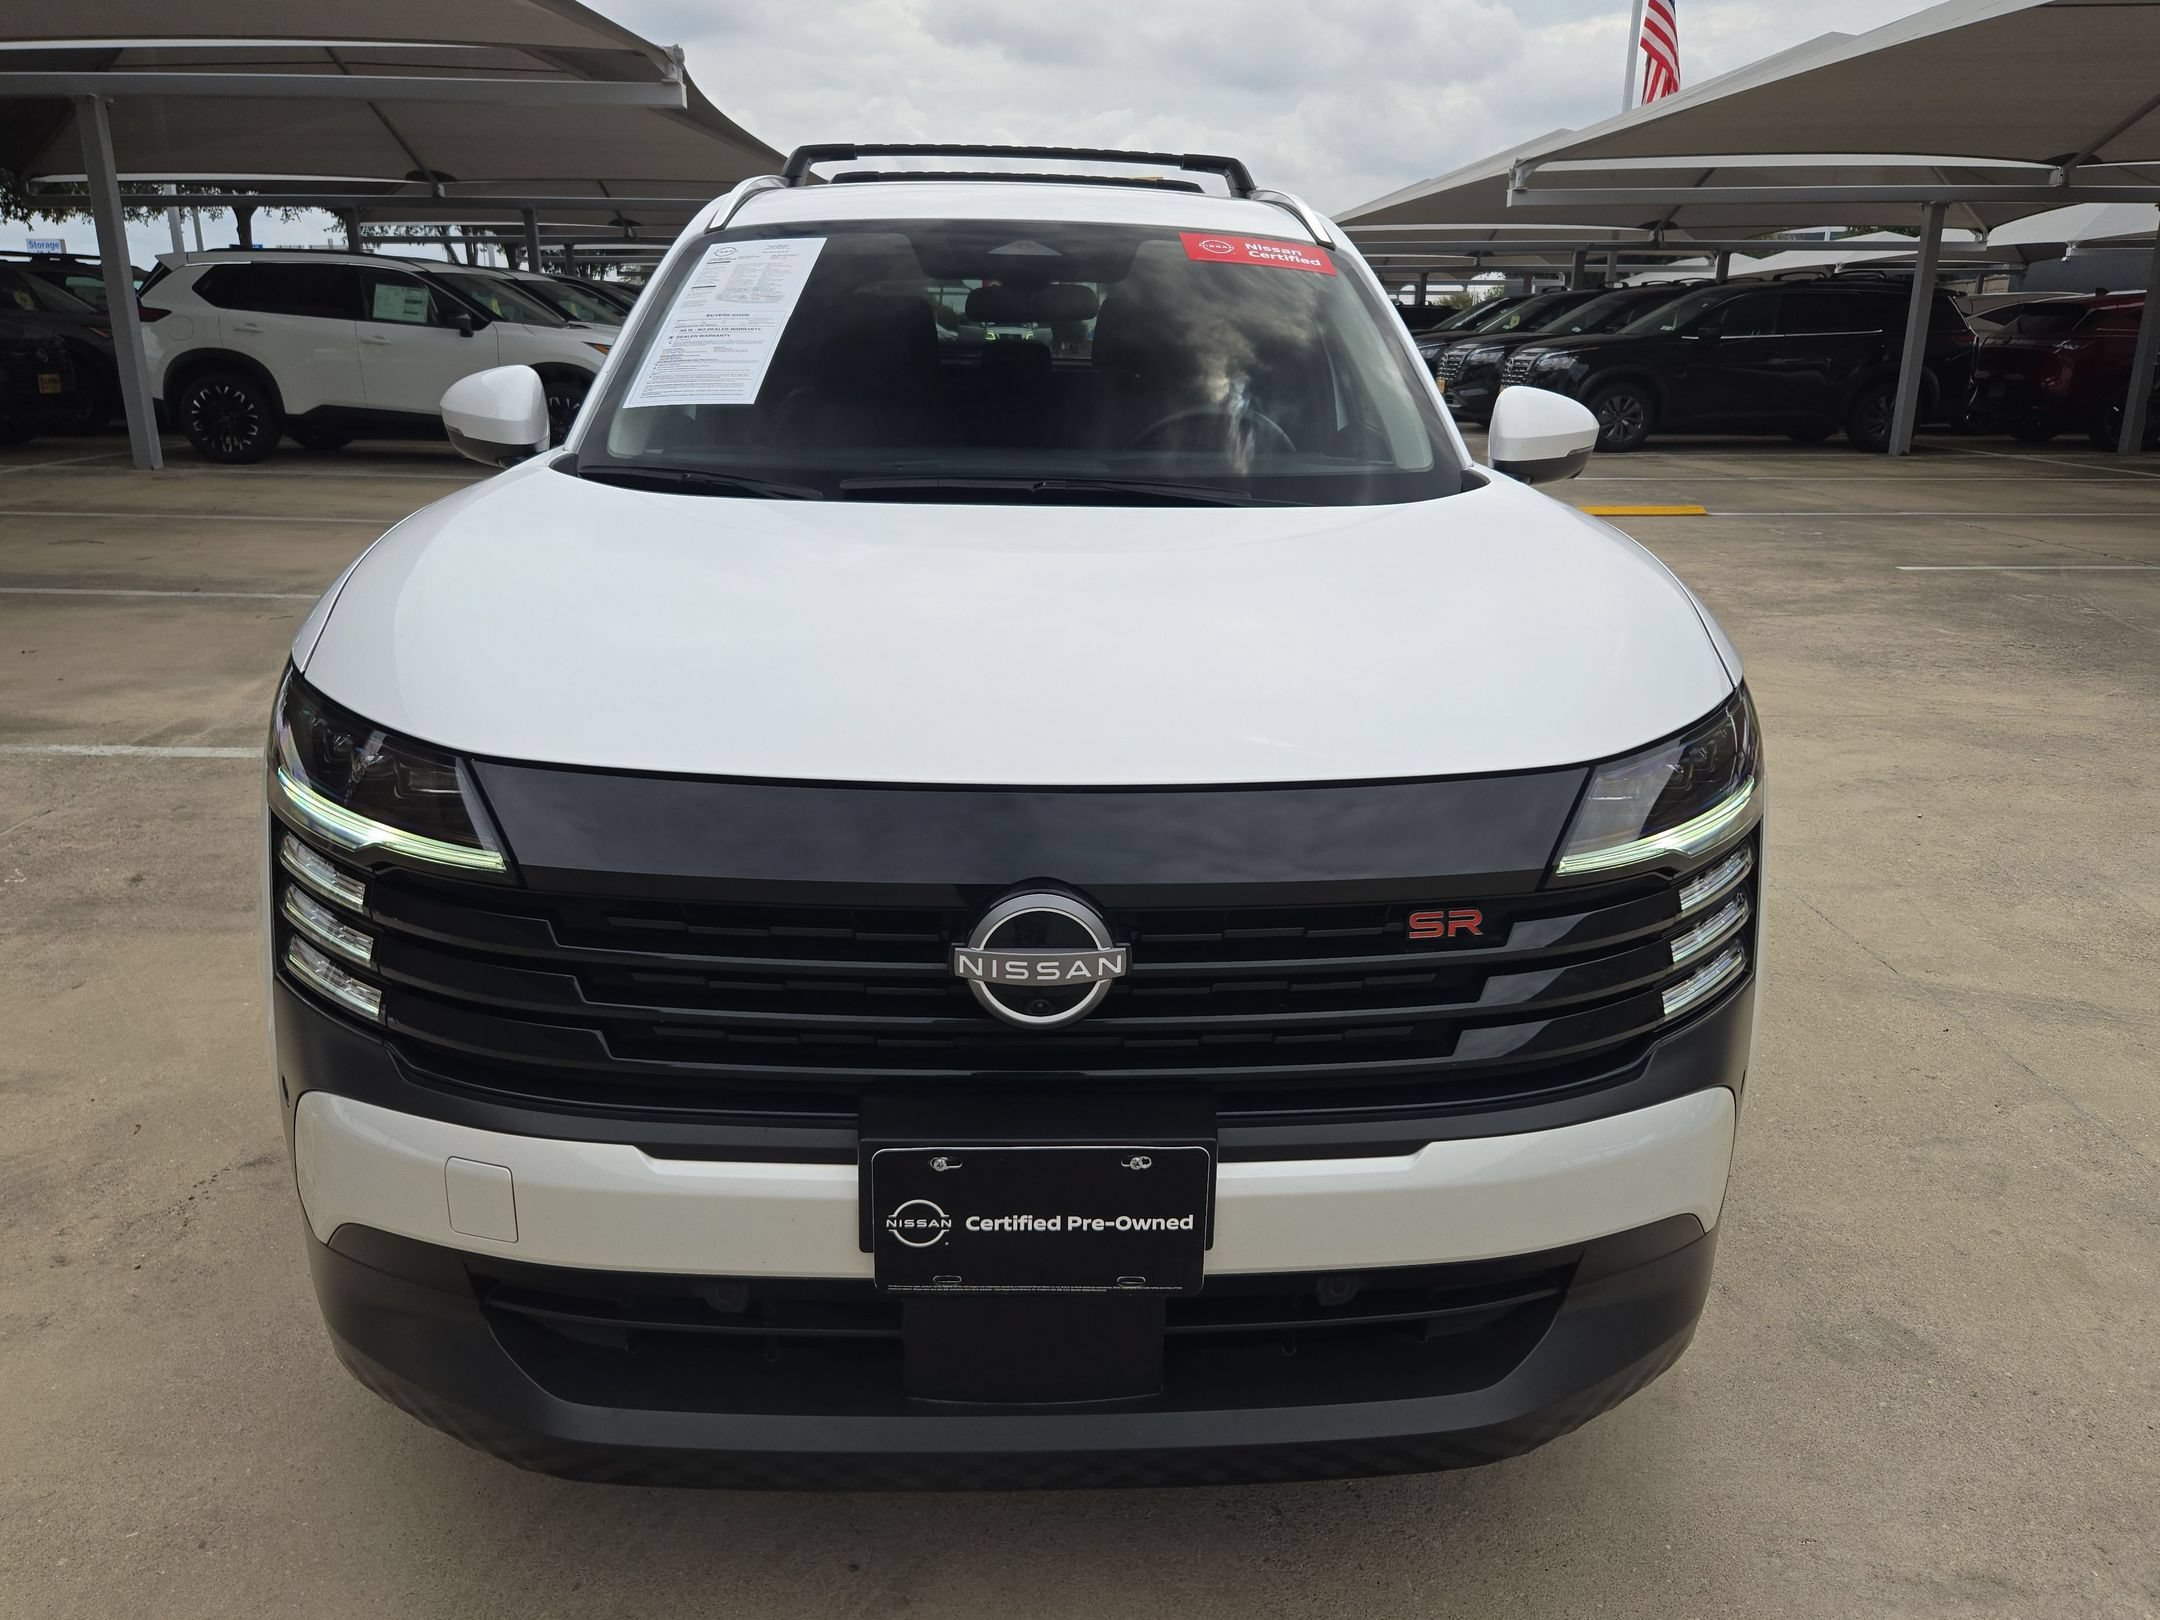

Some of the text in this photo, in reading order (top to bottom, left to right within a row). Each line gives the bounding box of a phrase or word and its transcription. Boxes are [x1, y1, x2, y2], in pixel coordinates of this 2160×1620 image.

[28, 240, 60, 251] Storage
[1245, 243, 1302, 256] Nissan
[1249, 251, 1322, 266] Certified
[1408, 909, 1483, 938] SR
[959, 954, 1122, 980] NISSAN
[886, 1215, 1194, 1231] NISSAN Certified Pre-Owned
